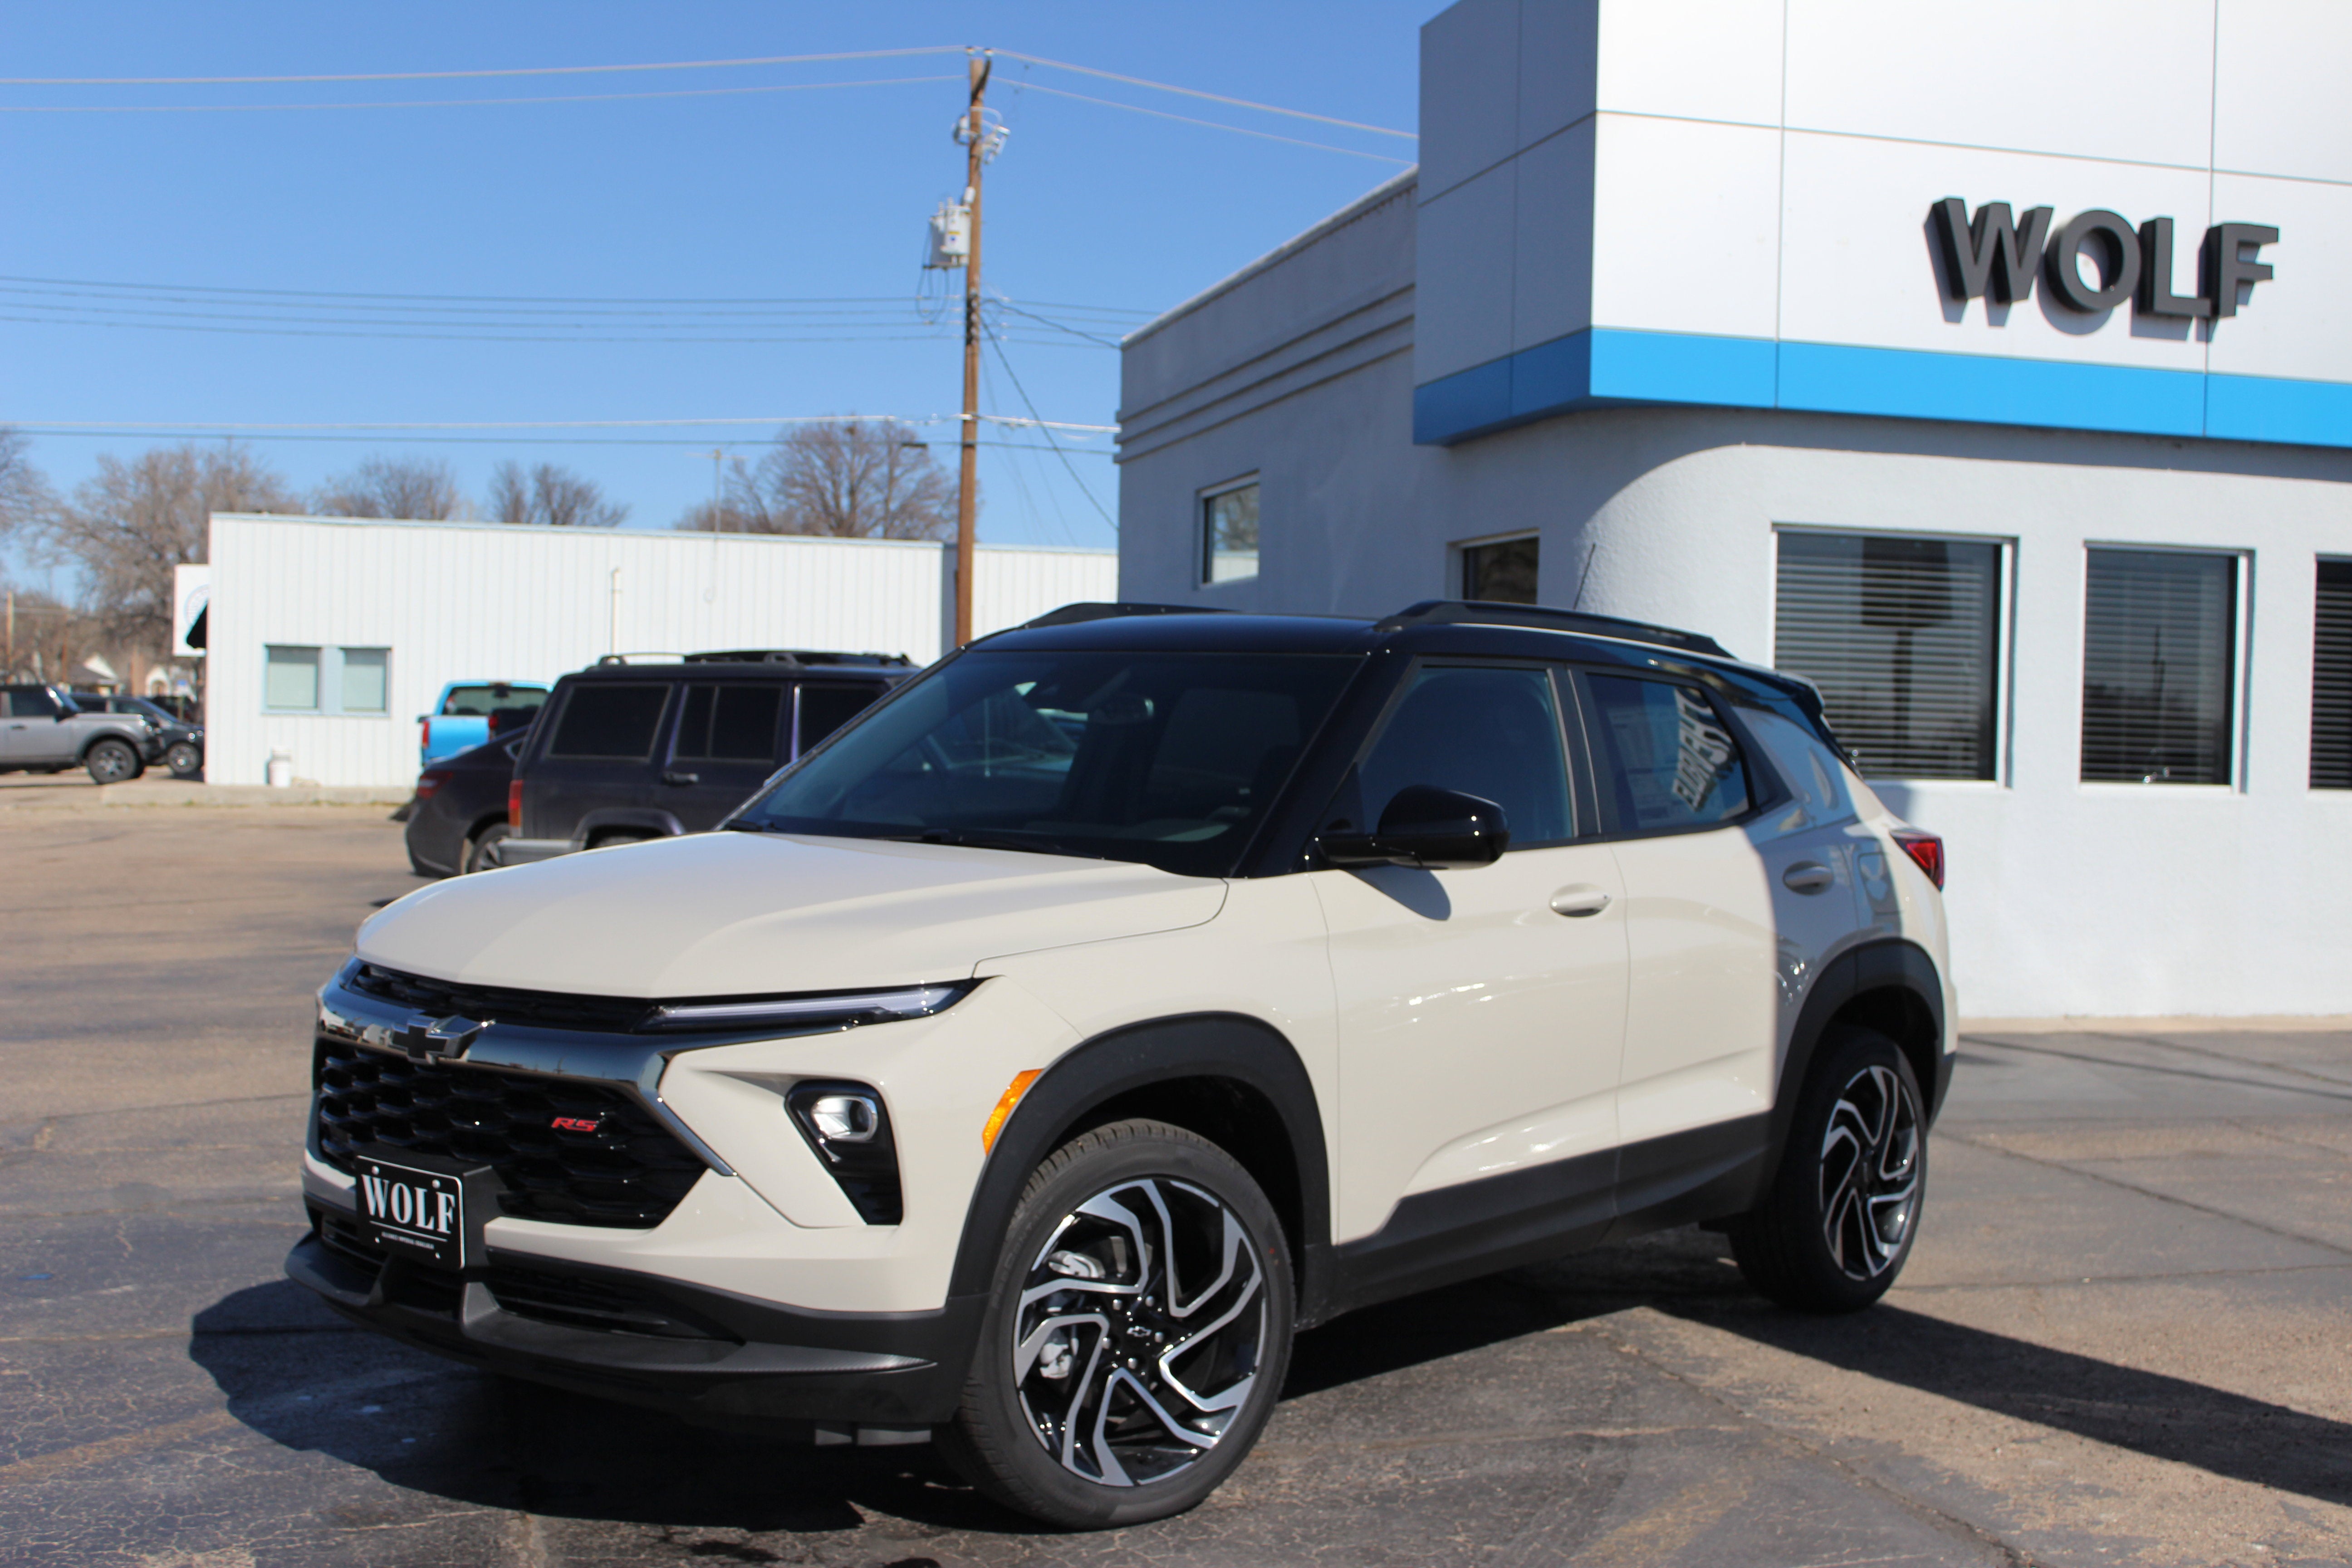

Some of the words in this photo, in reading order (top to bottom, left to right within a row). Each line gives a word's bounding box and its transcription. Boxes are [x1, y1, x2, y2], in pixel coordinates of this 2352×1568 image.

[1927, 196, 2279, 318] WOLF
[551, 1117, 599, 1132] RS
[361, 1173, 456, 1235] WOLF
